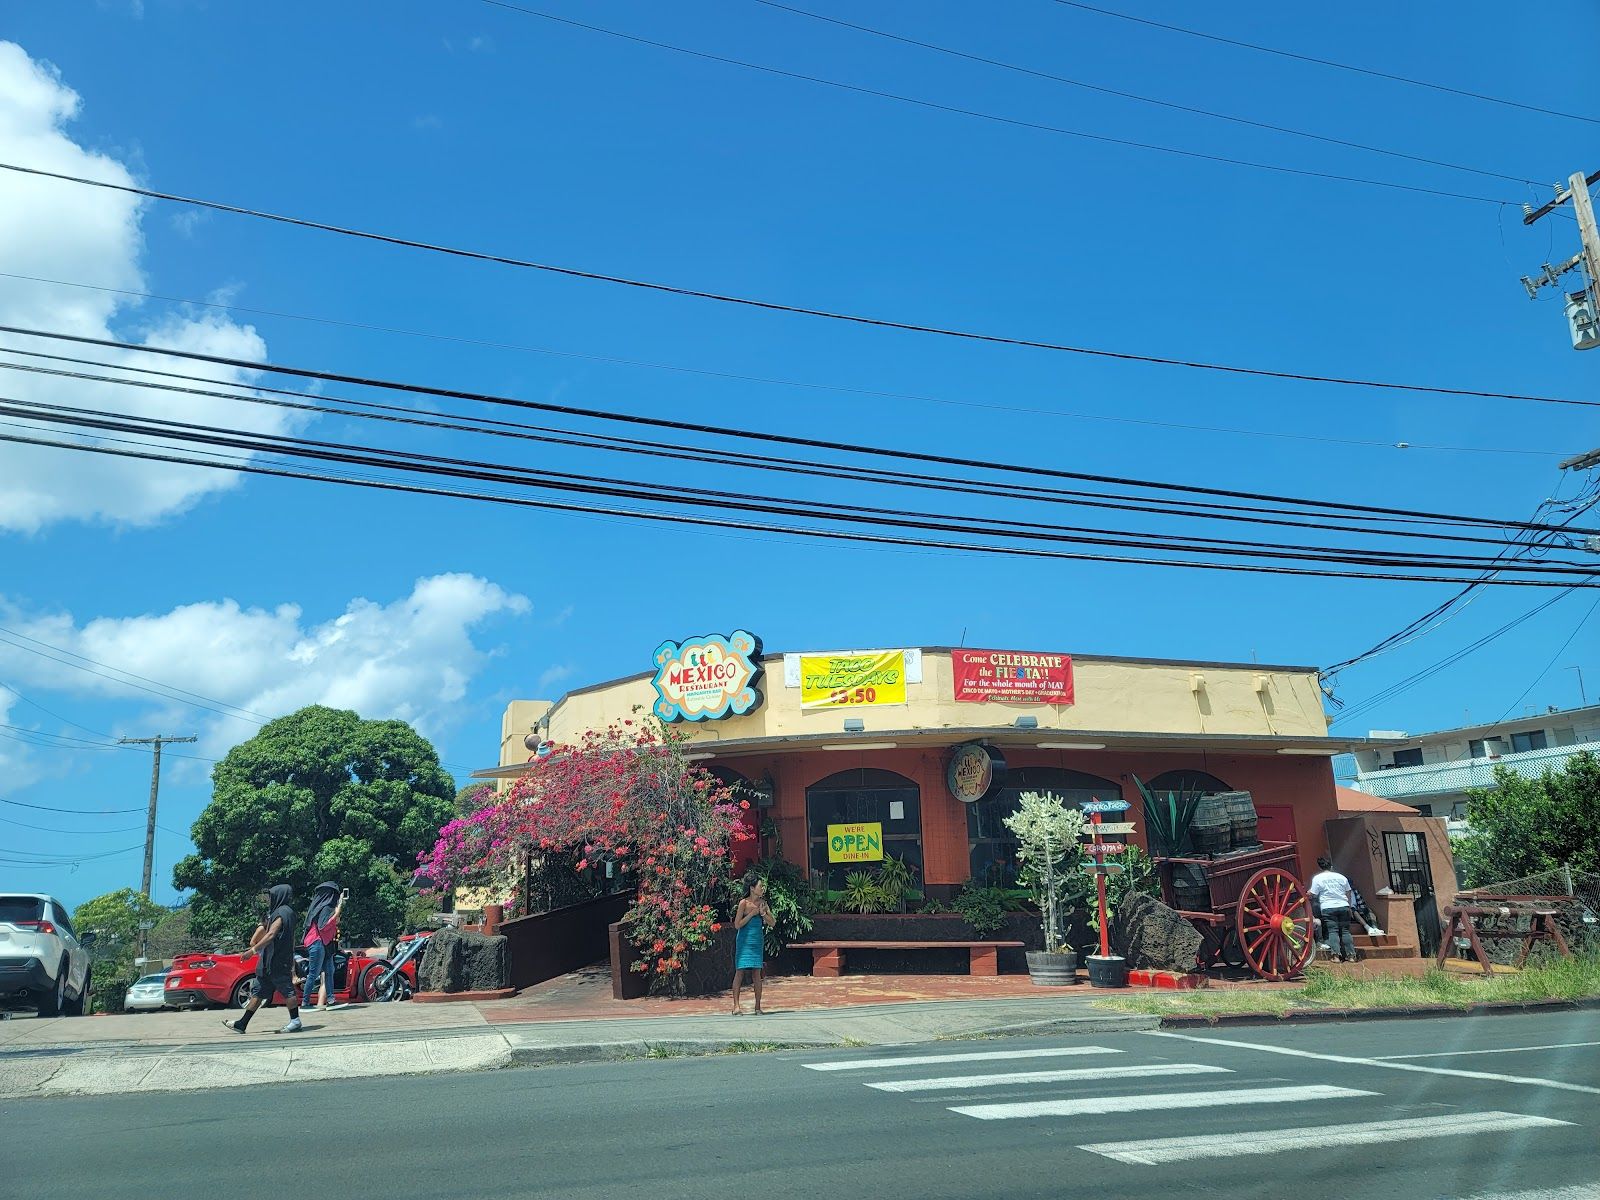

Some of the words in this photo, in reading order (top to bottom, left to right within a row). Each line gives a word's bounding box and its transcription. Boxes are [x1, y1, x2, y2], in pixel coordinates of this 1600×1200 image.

[829, 657, 877, 674] TACO
[963, 654, 987, 664] Come
[990, 653, 1062, 668] CELEBRATE
[669, 662, 736, 686] MEXICO
[805, 669, 900, 690] TUESDAYS
[979, 667, 993, 677] the
[996, 666, 1049, 680] FIESTA!!
[679, 680, 728, 693] RESTAURANT
[964, 679, 977, 687] For
[992, 680, 1013, 688] whole
[1014, 681, 1037, 689] month
[1039, 681, 1047, 691] of
[1047, 682, 1065, 690] MAY
[831, 832, 880, 852] OPEN
[843, 852, 870, 860] DINE-IN
